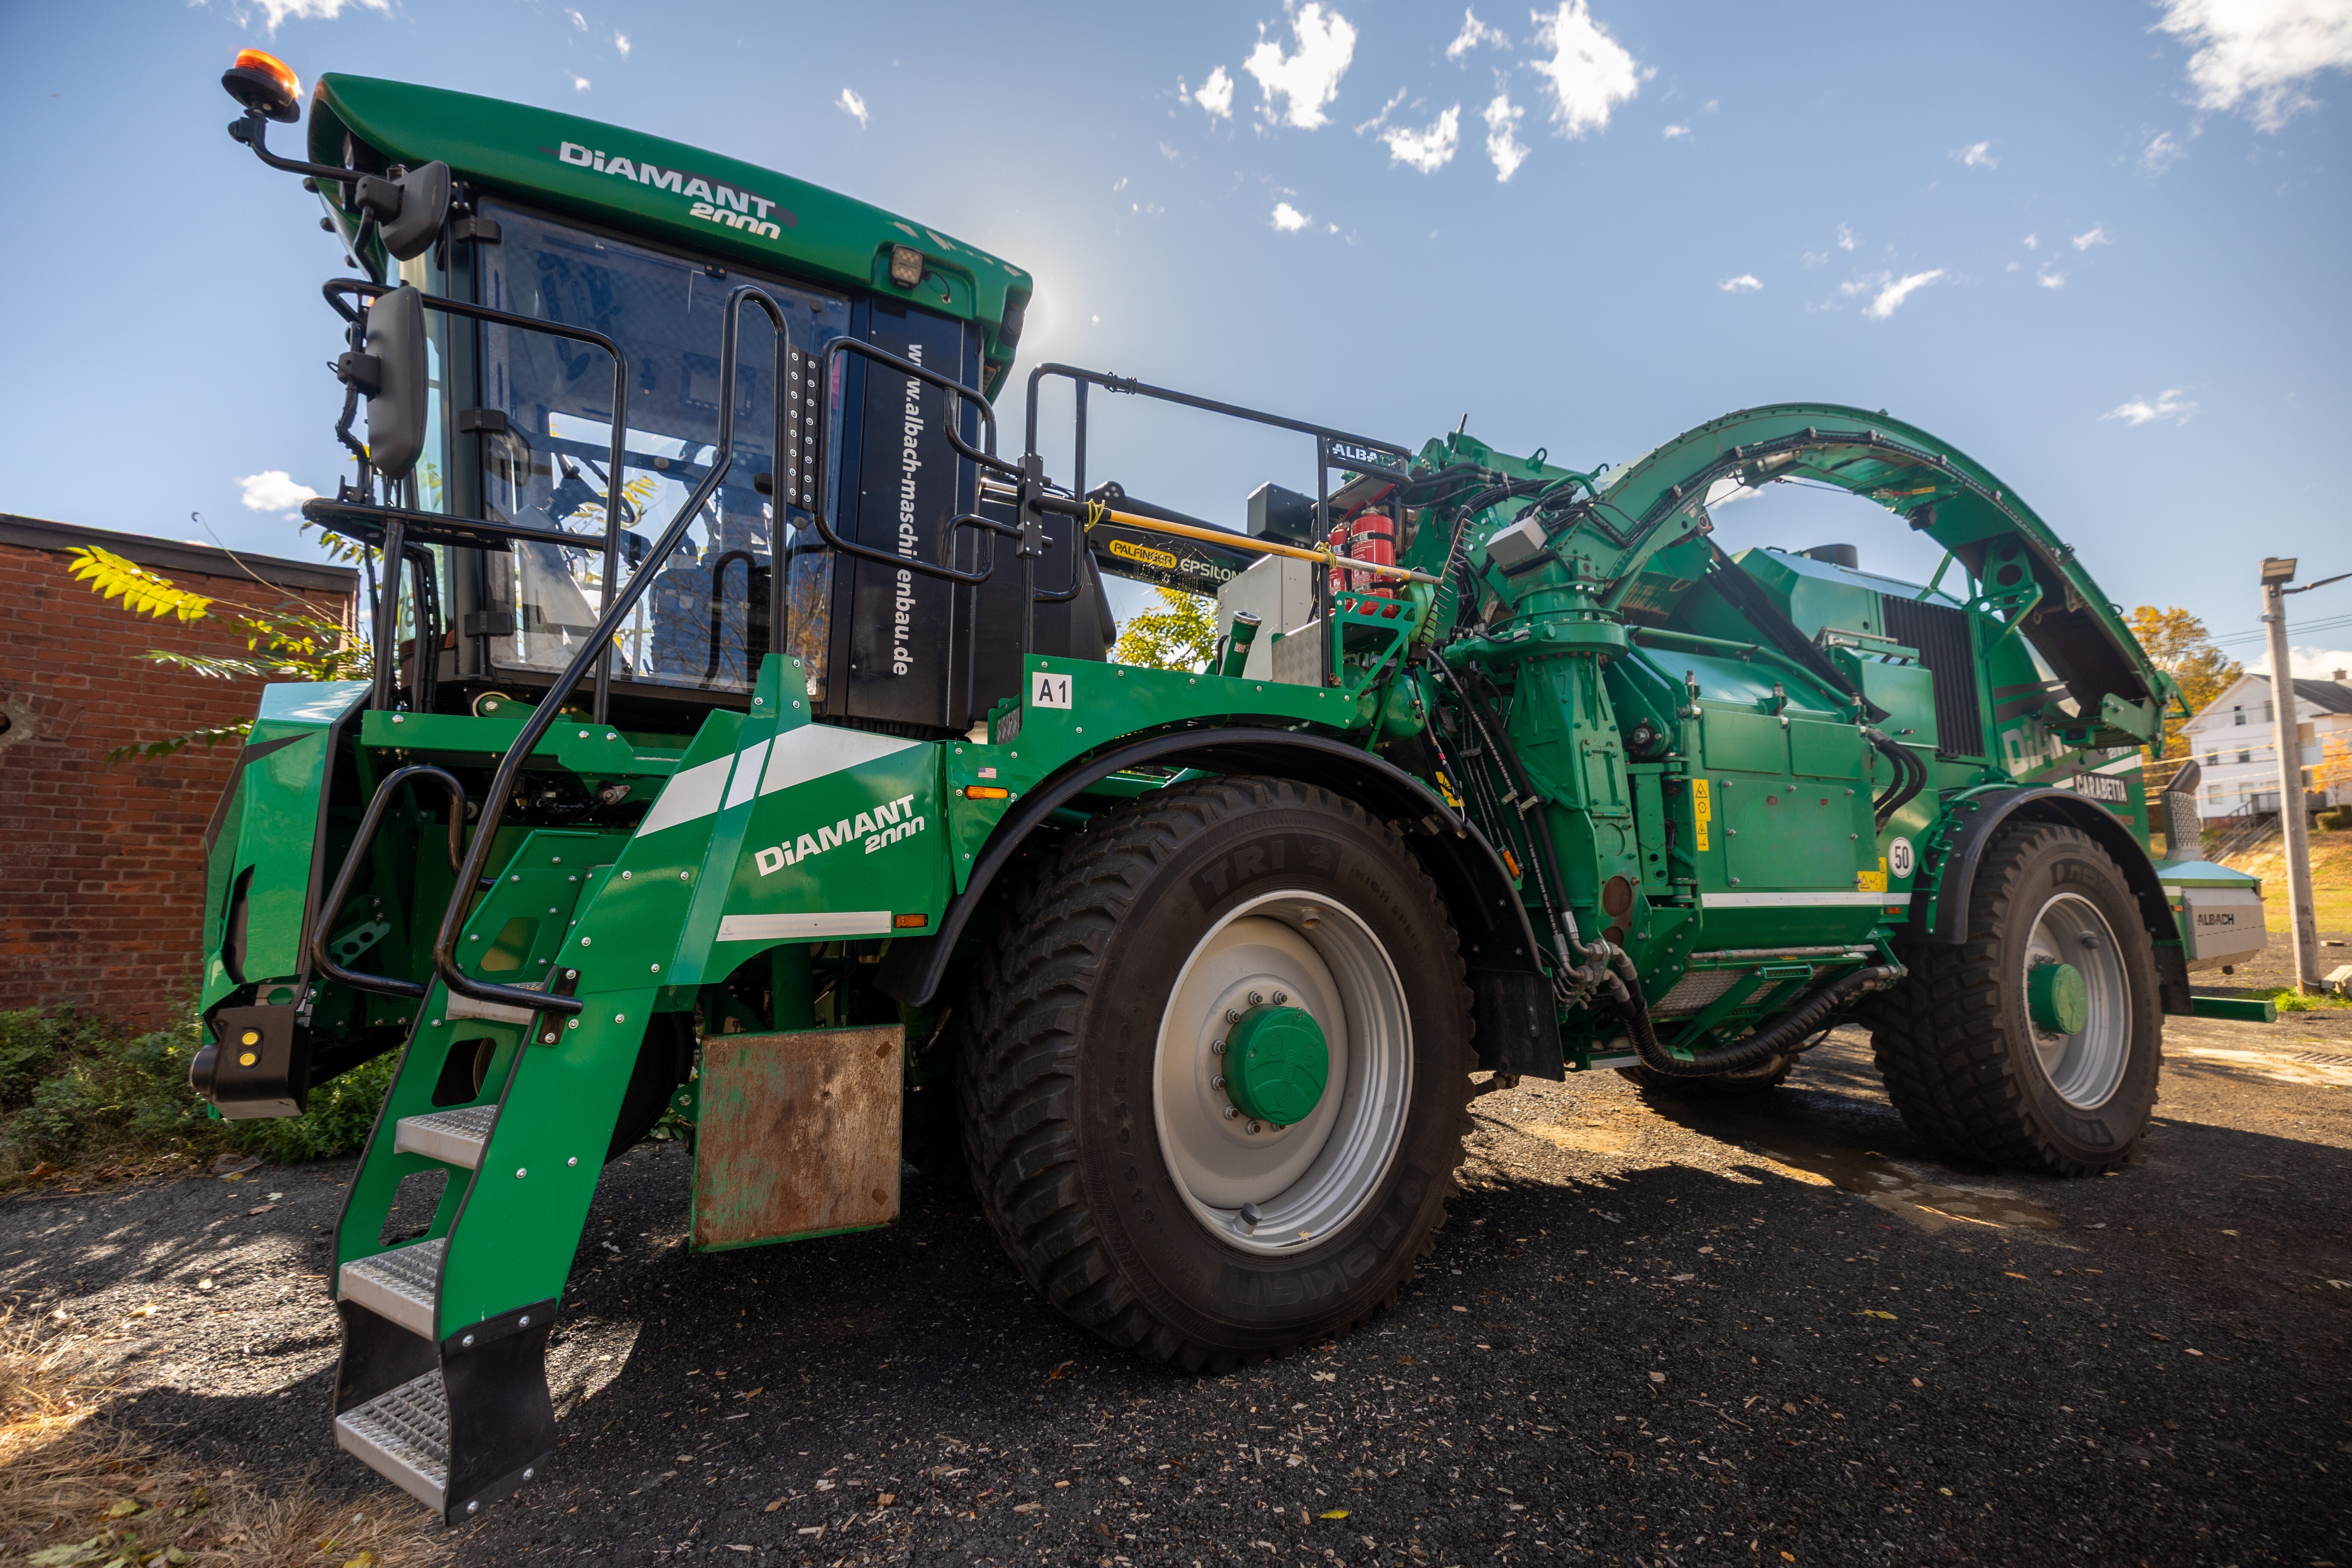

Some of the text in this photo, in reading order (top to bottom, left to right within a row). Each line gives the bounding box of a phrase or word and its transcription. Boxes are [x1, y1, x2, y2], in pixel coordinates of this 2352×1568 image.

[689, 202, 781, 240] 2000
[892, 343, 924, 676] ww.albach-maschienbau.de
[1114, 542, 1173, 565] PALFINGER
[1038, 679, 1066, 703] A1
[2075, 774, 2128, 802] CARABETTA
[865, 816, 925, 855] 2000
[1201, 840, 1332, 897] TRI 2
[1895, 846, 1909, 870] 50
[1354, 868, 1390, 903] HIGH
[2197, 913, 2234, 926] ALBACH
